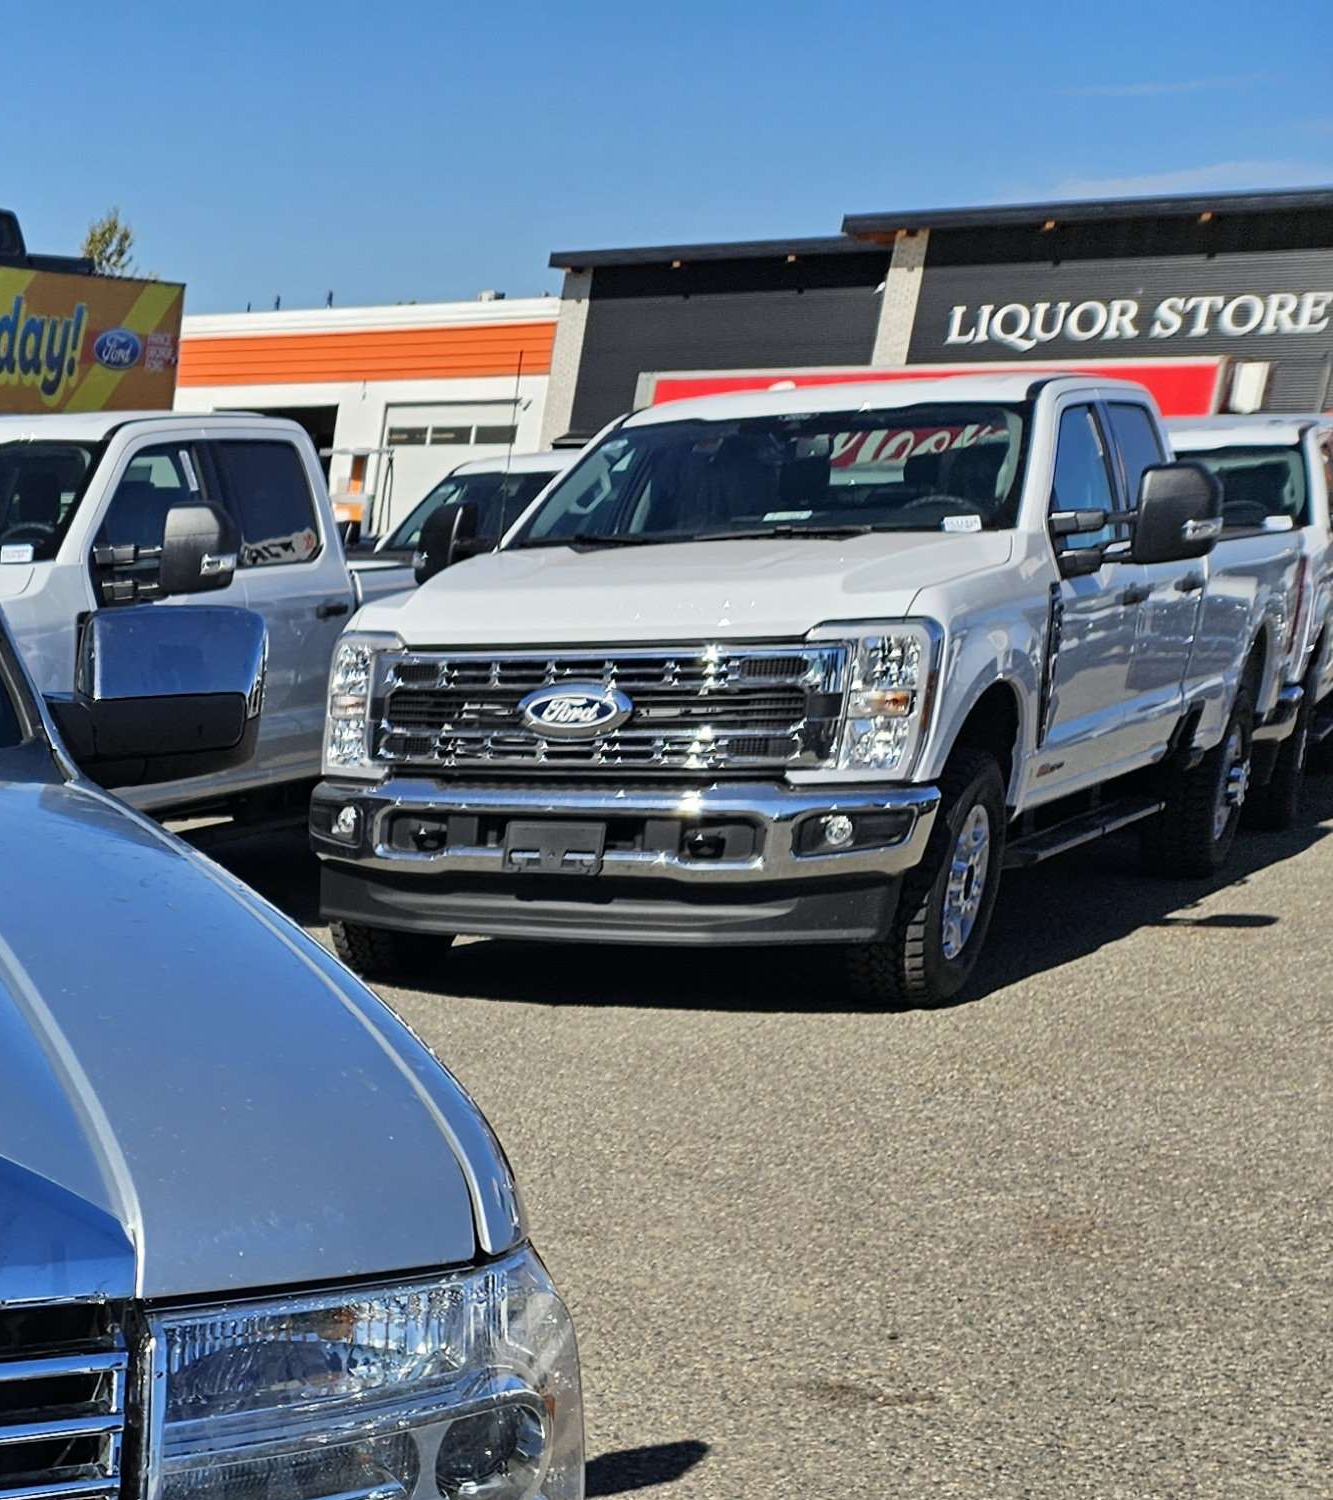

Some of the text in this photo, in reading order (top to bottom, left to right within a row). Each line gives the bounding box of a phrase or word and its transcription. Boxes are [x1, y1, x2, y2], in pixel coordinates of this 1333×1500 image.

[944, 291, 1333, 352] LIQUOR STORE
[540, 698, 601, 722] Ford
